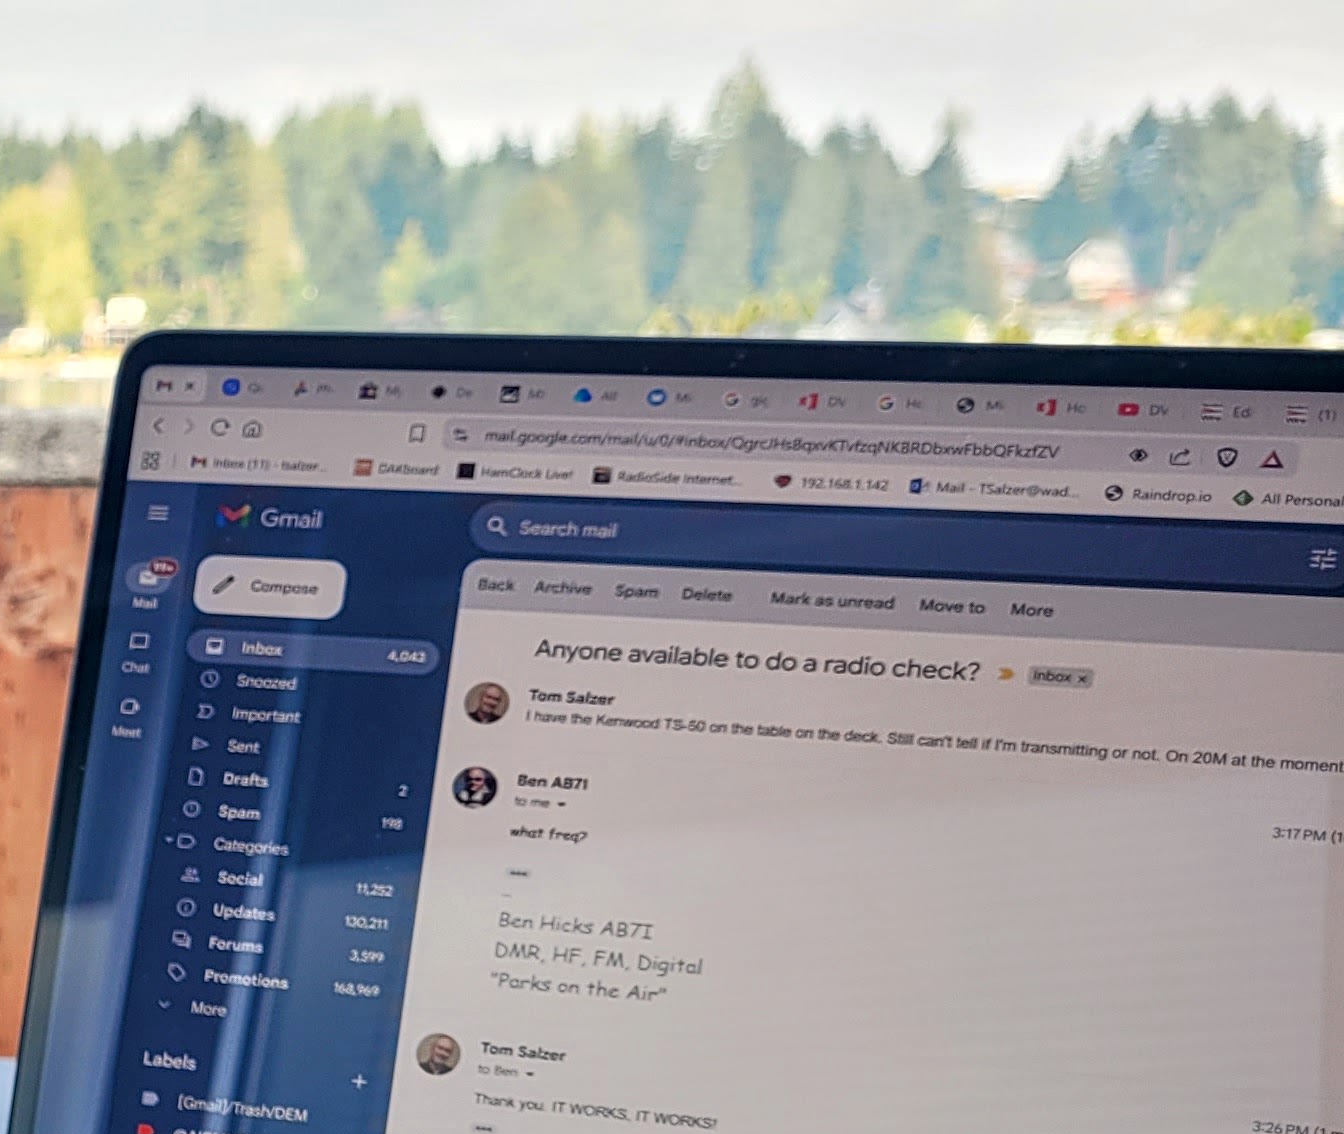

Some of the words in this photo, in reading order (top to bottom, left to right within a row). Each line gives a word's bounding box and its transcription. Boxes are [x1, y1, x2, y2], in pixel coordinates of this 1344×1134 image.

[260, 507, 323, 530] Gmail
[519, 520, 578, 537] Search
[582, 522, 619, 538] mail
[250, 579, 319, 597] Compose
[477, 577, 514, 592] Back
[534, 579, 593, 596] Archive
[614, 583, 659, 600] Spam
[681, 587, 733, 603] Delete
[770, 591, 811, 606] Mark
[814, 596, 834, 608] as
[837, 594, 896, 611] unread
[919, 598, 964, 614] Move
[969, 601, 986, 614] to
[1011, 602, 1054, 618] More
[241, 640, 284, 657] Inbox
[534, 639, 624, 665] Anyone
[628, 645, 729, 669] available
[735, 649, 759, 670] to
[765, 651, 797, 673] do
[802, 658, 818, 674] a
[823, 653, 886, 677] radio
[892, 658, 981, 682] check?
[529, 688, 562, 703] Tom
[565, 690, 616, 706] Salzer
[232, 705, 302, 725] Important
[227, 738, 261, 754] Sent
[534, 711, 567, 724] have
[571, 712, 592, 725] the
[595, 714, 660, 730] Kenwood
[709, 723, 727, 734] on
[731, 722, 753, 736] the
[757, 724, 792, 738] table
[795, 727, 814, 739] on
[817, 727, 841, 741] the
[844, 728, 883, 744] deck.
[887, 731, 914, 746] Still
[917, 734, 953, 749] can't
[956, 736, 979, 750] tell
[994, 738, 1017, 752] I'm
[1020, 740, 1109, 761] transmitting
[1112, 748, 1127, 759] or
[1132, 749, 1160, 762] not.
[1165, 749, 1188, 763] On
[1192, 751, 1228, 766] 20M
[1230, 754, 1247, 767] at
[1251, 755, 1276, 769] the
[1279, 758, 1344, 773] moment
[222, 771, 270, 789] Drafts
[218, 804, 262, 821] Spam
[217, 870, 265, 888] Social
[212, 902, 277, 922] Updates
[499, 911, 534, 930] Ben
[540, 915, 595, 935] Hicks
[599, 921, 655, 941] AB7I
[208, 936, 264, 954] Forums
[494, 941, 546, 964] DMR,
[552, 946, 587, 968] HF,
[593, 950, 631, 972] FM,
[637, 954, 704, 977] Digital
[203, 968, 290, 991] Promotions
[490, 970, 552, 992] "Parks
[558, 980, 580, 995] on
[588, 980, 620, 999] the
[627, 984, 668, 1002] Air"
[190, 1000, 228, 1018] More
[142, 1050, 198, 1073] Labels
[1252, 1120, 1283, 1134] 3:26
